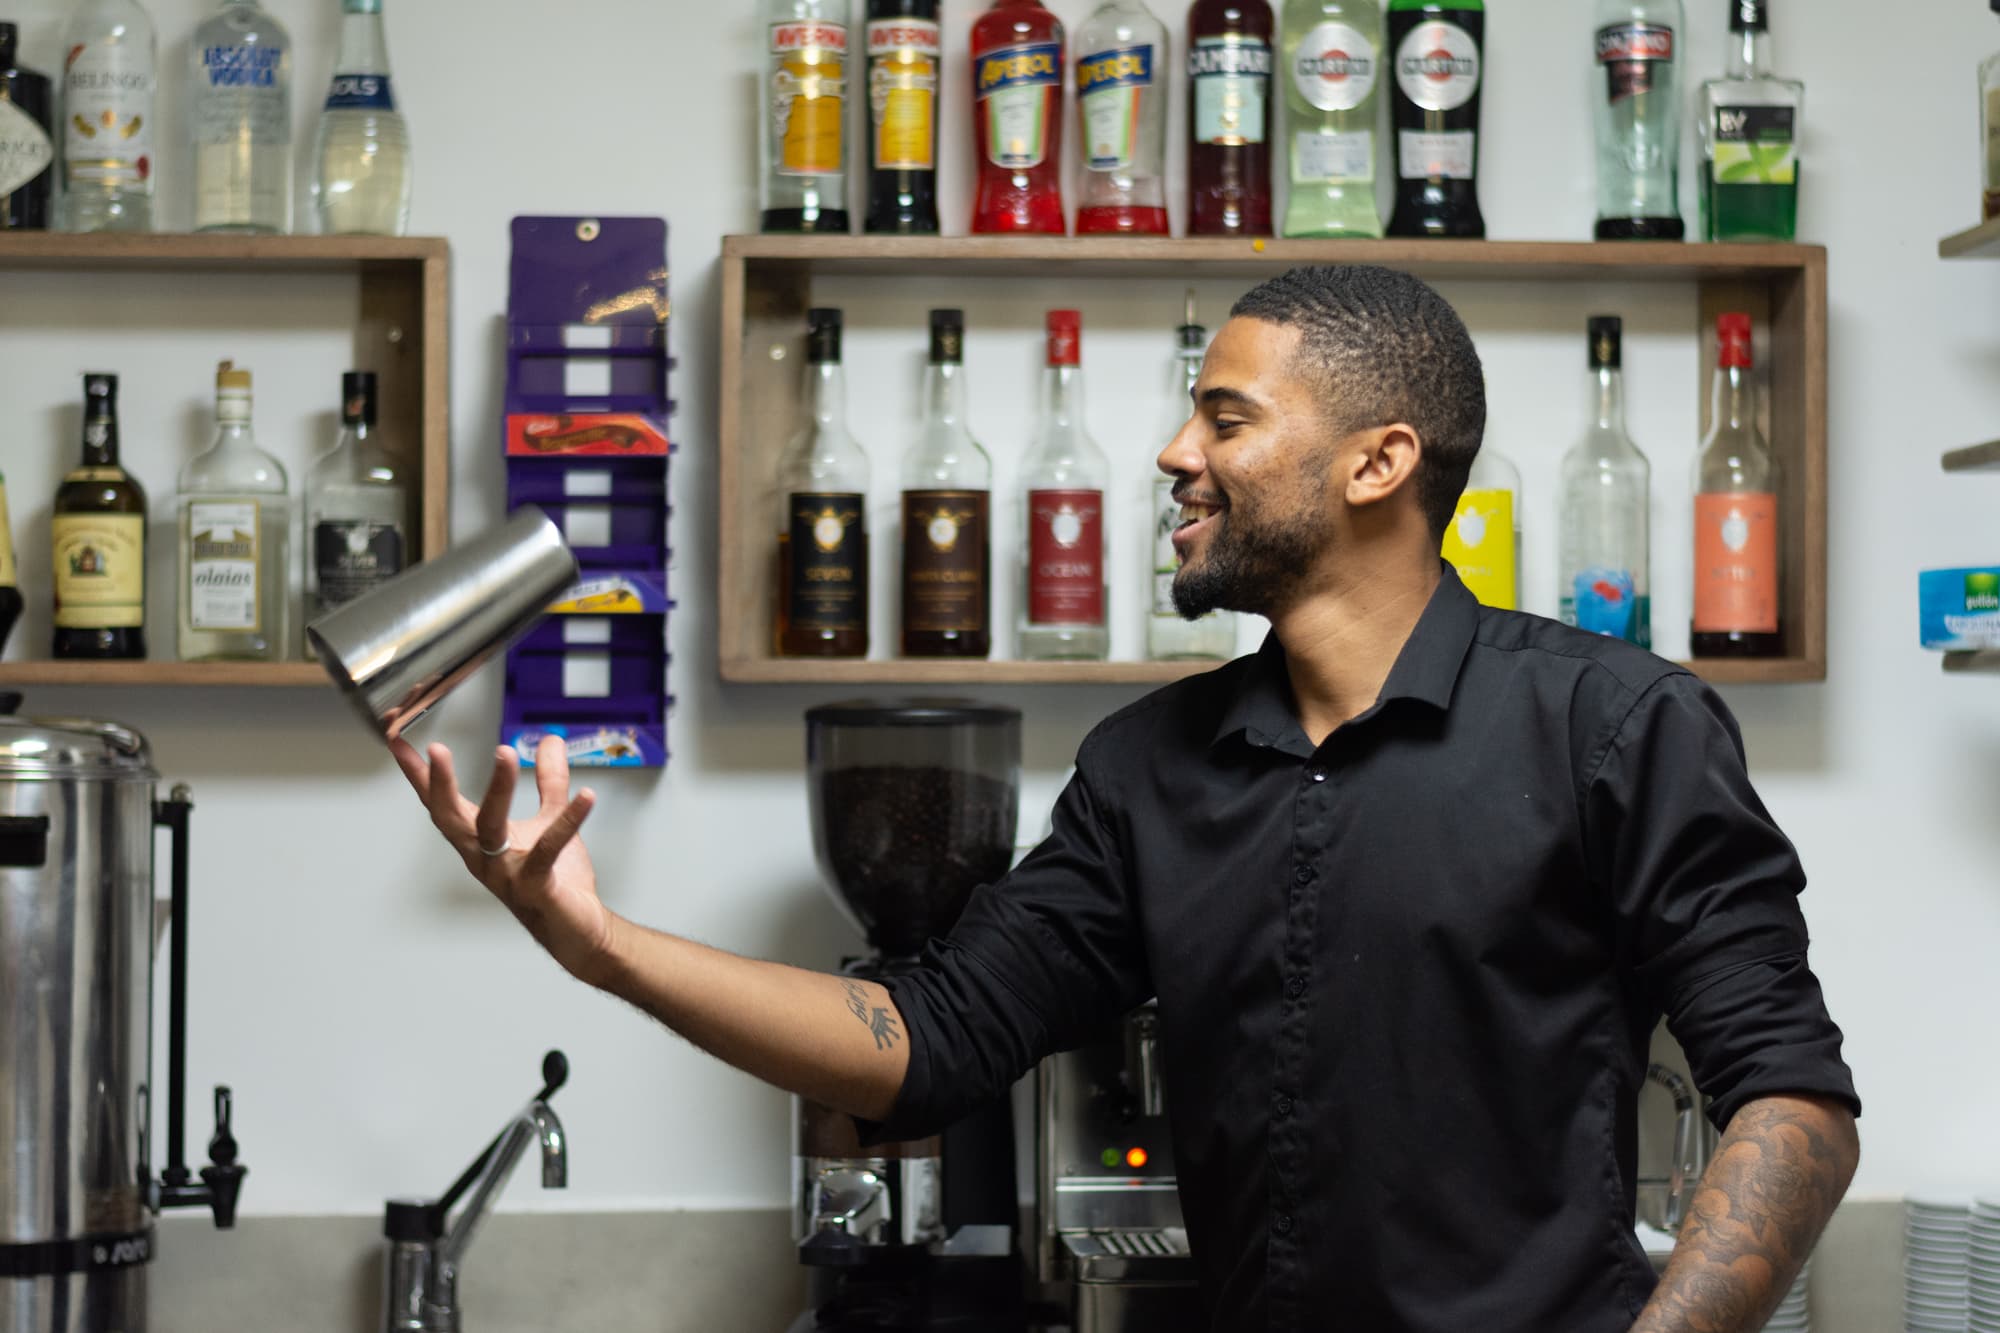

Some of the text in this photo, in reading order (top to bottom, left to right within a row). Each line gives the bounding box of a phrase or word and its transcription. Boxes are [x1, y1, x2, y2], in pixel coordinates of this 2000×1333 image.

[208, 67, 275, 88] VODKA
[979, 53, 1056, 88] APEROL
[1299, 58, 1370, 77] MARTINI
[1402, 58, 1474, 77] MARTINI
